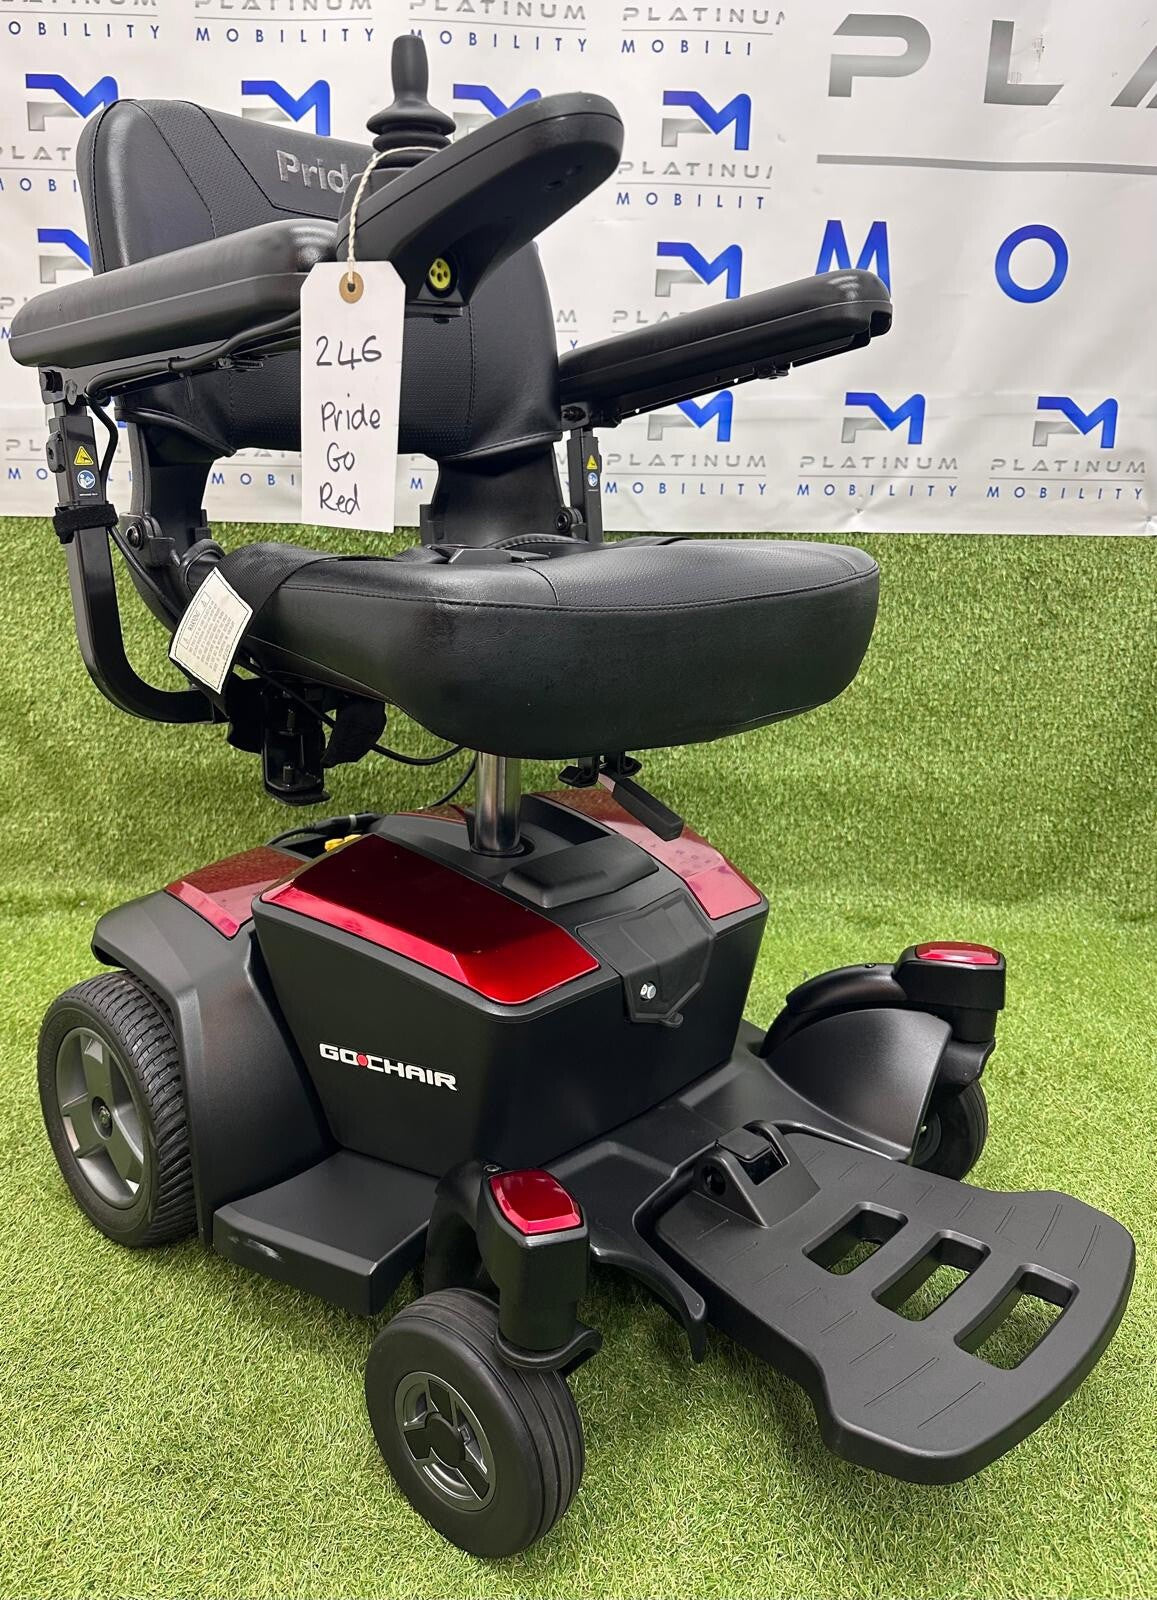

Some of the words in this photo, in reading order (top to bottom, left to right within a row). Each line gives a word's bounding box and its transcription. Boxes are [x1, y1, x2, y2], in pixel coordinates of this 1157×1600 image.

[196, 27, 374, 43] MOBILITY
[316, 334, 382, 370] 246
[320, 392, 382, 432] Pride
[326, 441, 356, 473] Go
[606, 452, 767, 468] PLATINUM
[799, 455, 959, 470] PLATINUM
[990, 458, 1146, 473] PLATINUM
[605, 482, 767, 496] MOBILITY
[796, 483, 959, 498] MOBILITY
[986, 485, 1144, 500] MOBILITY
[320, 481, 361, 515] Red
